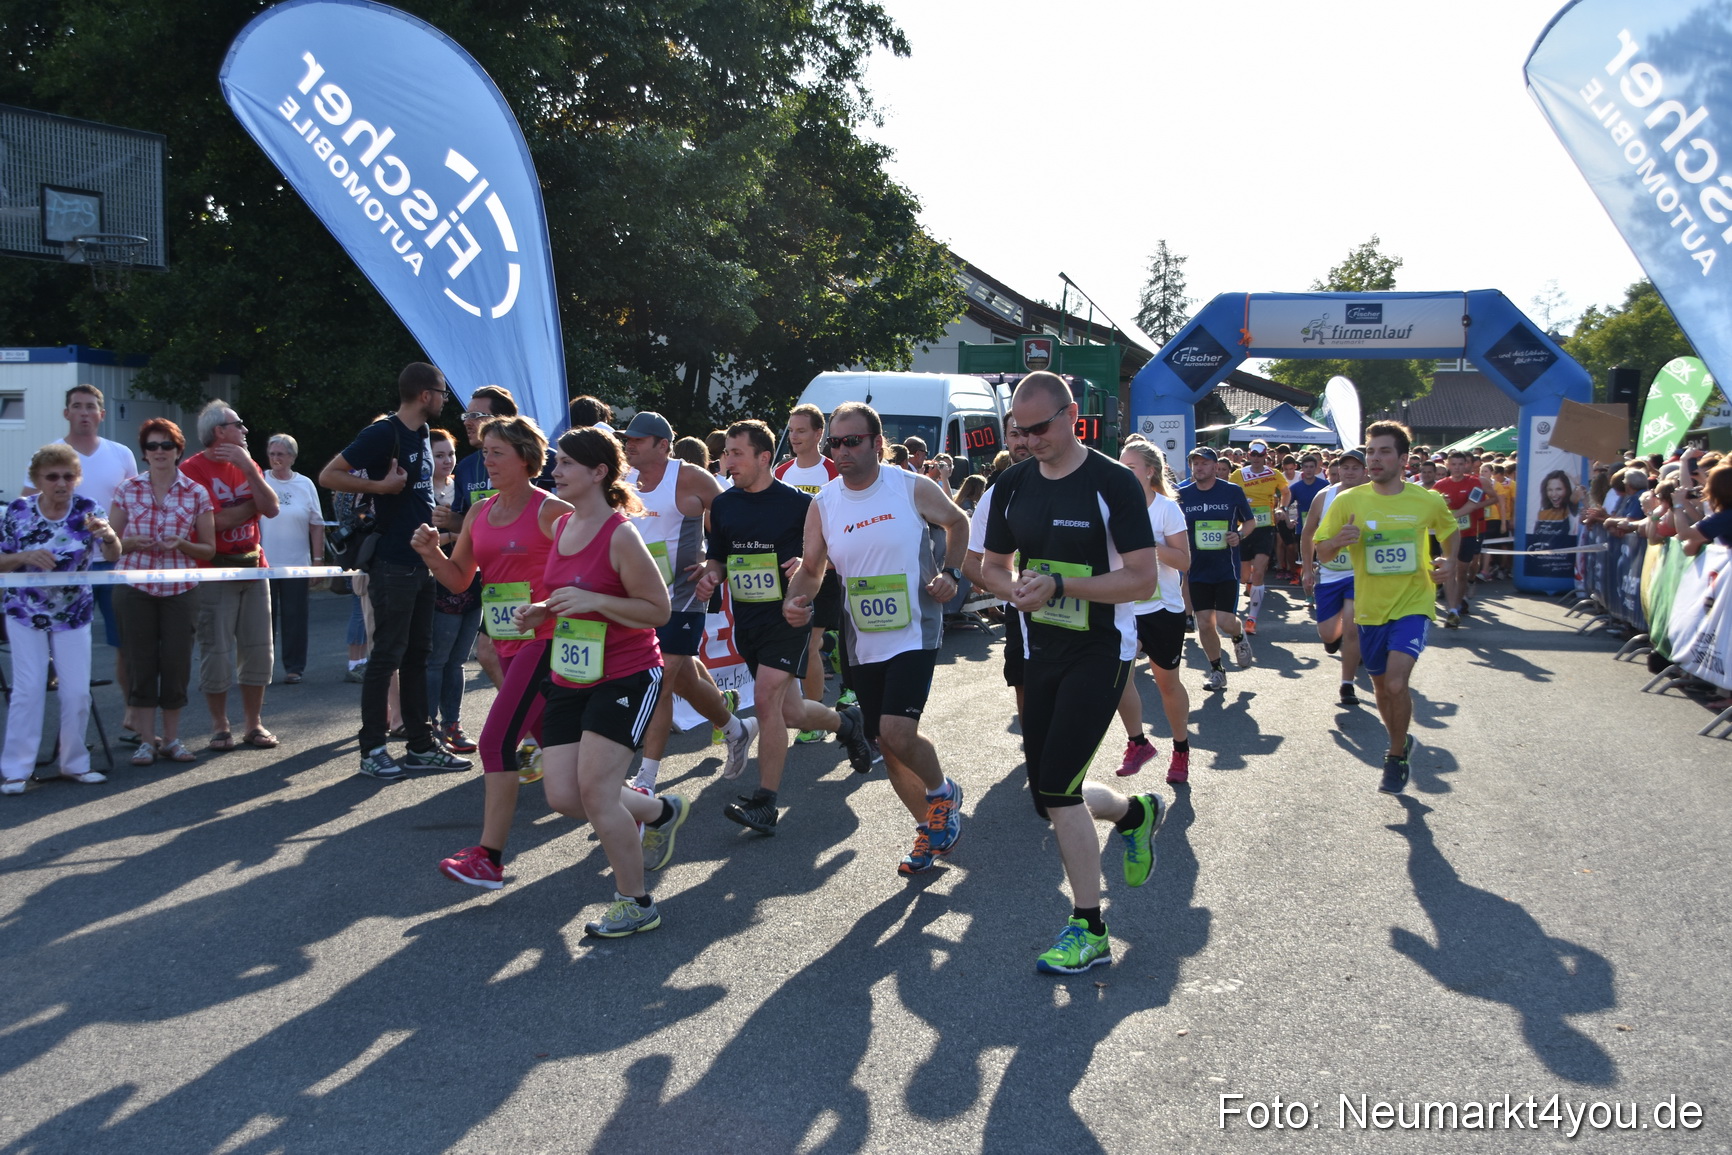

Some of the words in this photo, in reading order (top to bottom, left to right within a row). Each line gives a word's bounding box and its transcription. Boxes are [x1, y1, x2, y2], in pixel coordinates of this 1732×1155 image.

[1332, 324, 1414, 340] firmenlauf
[1180, 352, 1223, 362] Fischer
[1642, 412, 1676, 445] AOK
[467, 481, 486, 490] EURO
[1244, 480, 1260, 488] MAX
[1186, 505, 1203, 513] EURO
[1208, 503, 1229, 511] POLES
[856, 513, 896, 529] KLEBL
[1058, 519, 1090, 528] PFLEIDERER
[1201, 532, 1222, 542] 369
[1374, 547, 1407, 564] 659
[733, 573, 775, 590] 1319
[860, 597, 898, 617] 606
[561, 643, 589, 667] 361
